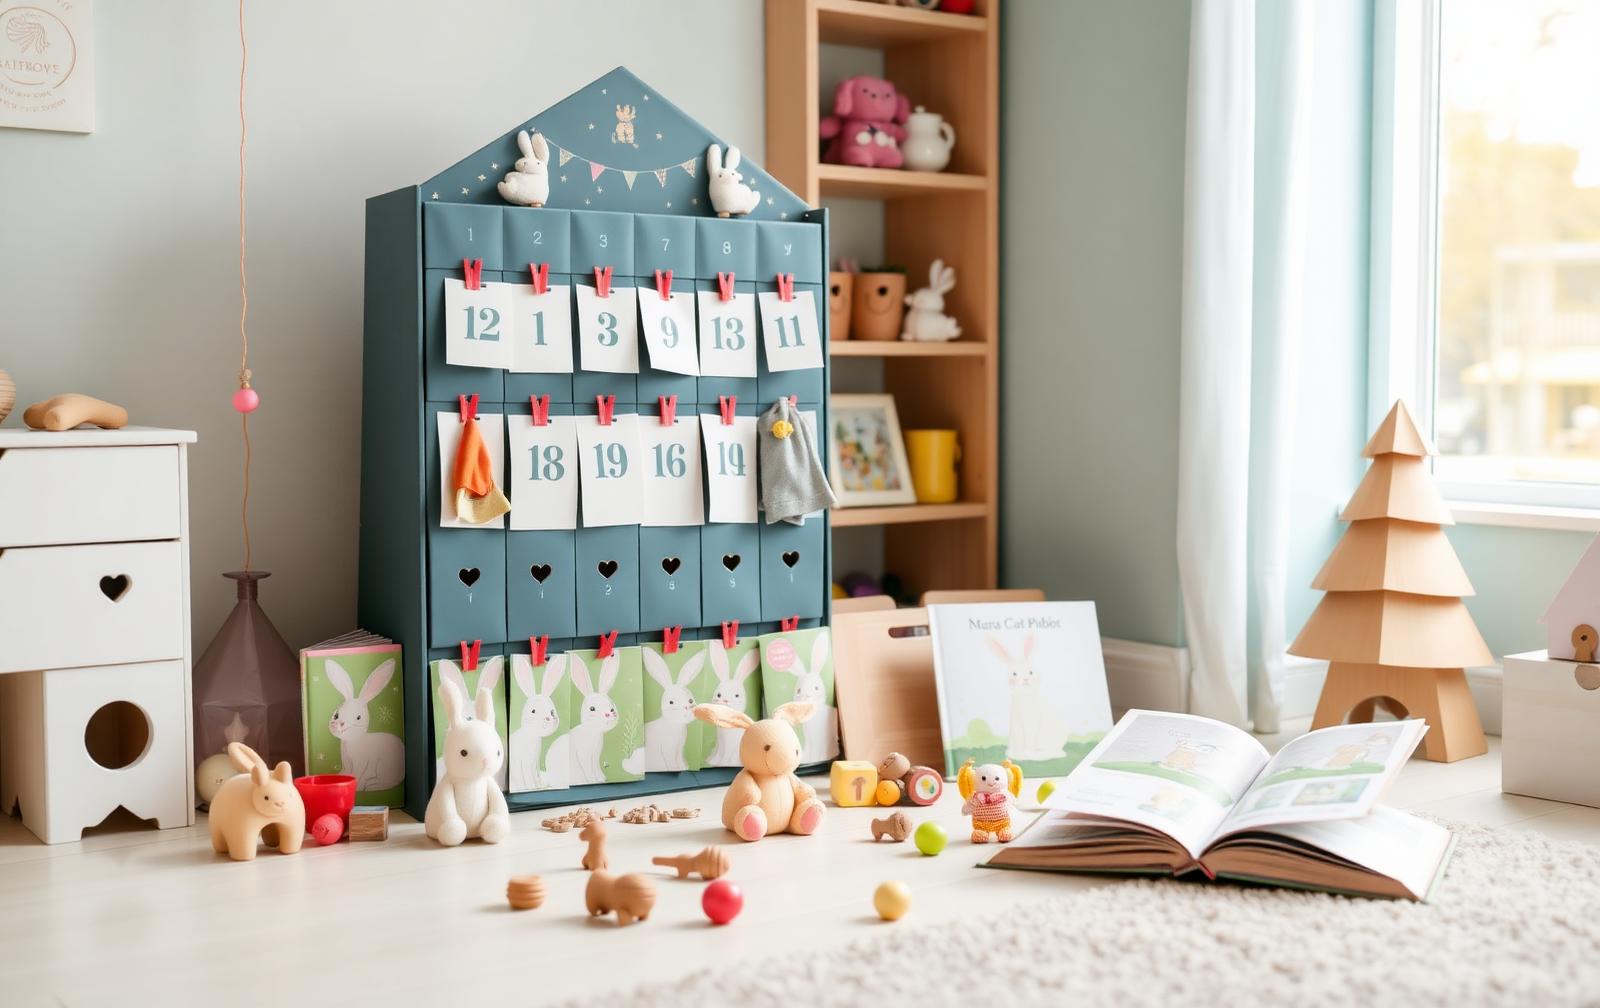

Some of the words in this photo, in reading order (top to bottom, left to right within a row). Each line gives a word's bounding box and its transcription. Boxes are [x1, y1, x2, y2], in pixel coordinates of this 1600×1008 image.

[467, 227, 473, 242] 1
[533, 231, 542, 245] 2
[599, 234, 608, 248] 3
[662, 238, 670, 252] 7
[722, 241, 732, 255] 8
[463, 305, 500, 342] 12
[532, 311, 548, 346] 1
[597, 311, 619, 347] 3
[660, 316, 679, 349] 9
[710, 316, 745, 351] 13
[774, 314, 806, 349] 11
[528, 444, 565, 481] 18
[593, 442, 628, 479] 19
[652, 443, 687, 478] 16
